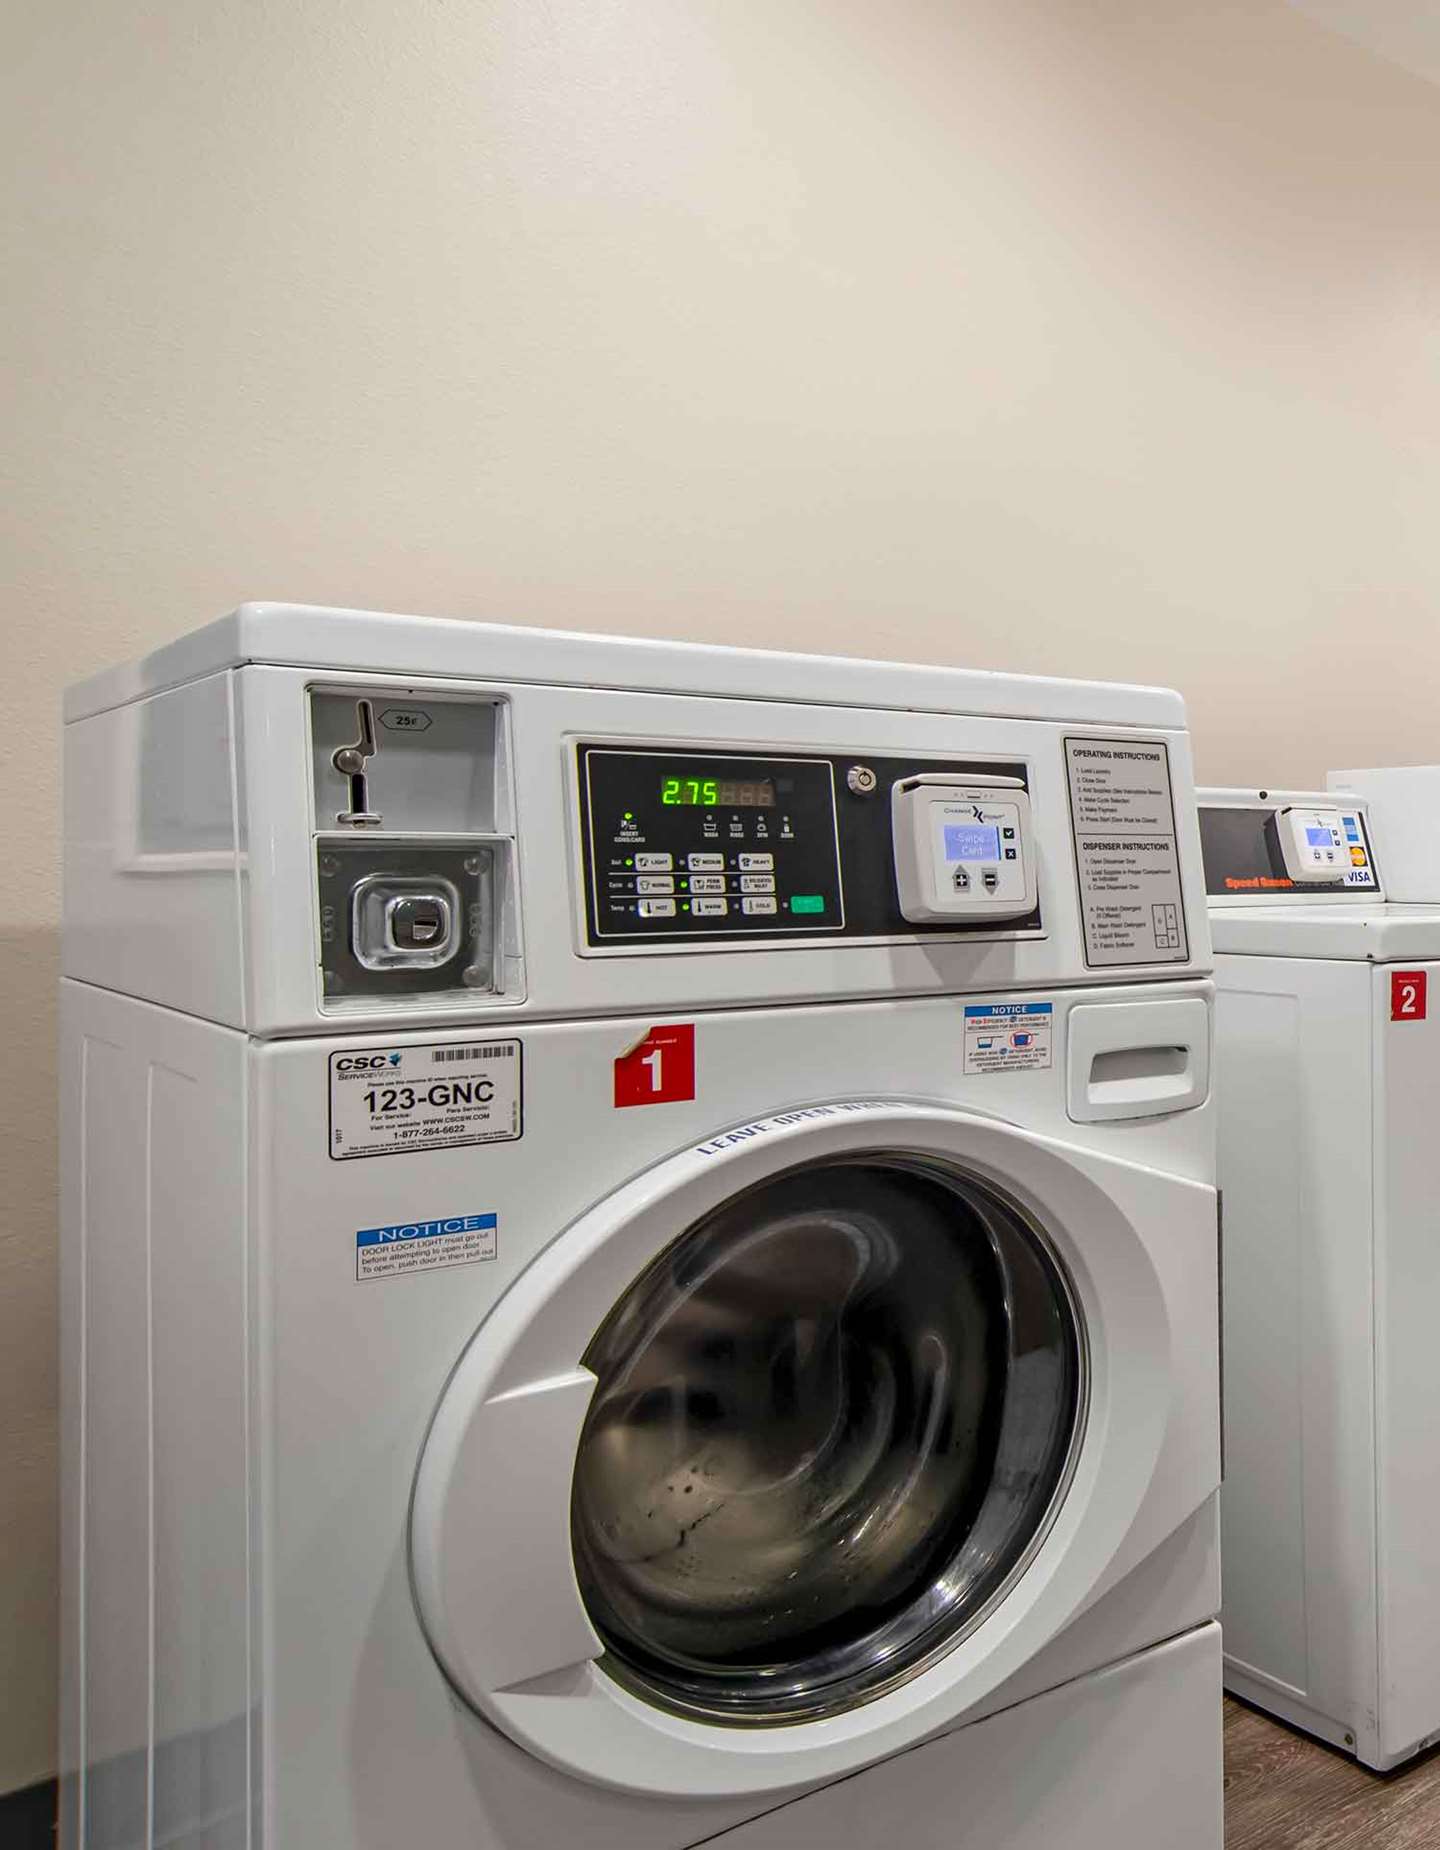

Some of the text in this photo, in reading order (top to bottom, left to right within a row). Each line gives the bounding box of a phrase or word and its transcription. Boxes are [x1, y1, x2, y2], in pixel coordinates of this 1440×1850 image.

[1073, 749, 1160, 761] OPERATING INSTRUCTIONS
[662, 781, 718, 805] 2.75
[1083, 842, 1169, 851] DISPENSER INSTRUCTIONS
[1225, 876, 1260, 889] Speed
[1348, 871, 1371, 883] VISA
[991, 1005, 1028, 1014] NOTICE
[1401, 985, 1416, 1013] 2
[336, 1055, 386, 1071] CSC
[642, 1049, 662, 1091] 1
[363, 1080, 495, 1113] 123-GNC
[393, 1124, 466, 1140] 1-877-264-6622
[697, 1106, 836, 1155] LEAVE OPEN
[379, 1217, 480, 1242] NOTICE
[361, 1232, 489, 1257] DOOR LOCK LIGHT must go out
[362, 1242, 480, 1266] before attempting to open door
[398, 1260, 418, 1270] push
[419, 1257, 437, 1266] door
[448, 1252, 465, 1261] then
[466, 1250, 480, 1260] pull
